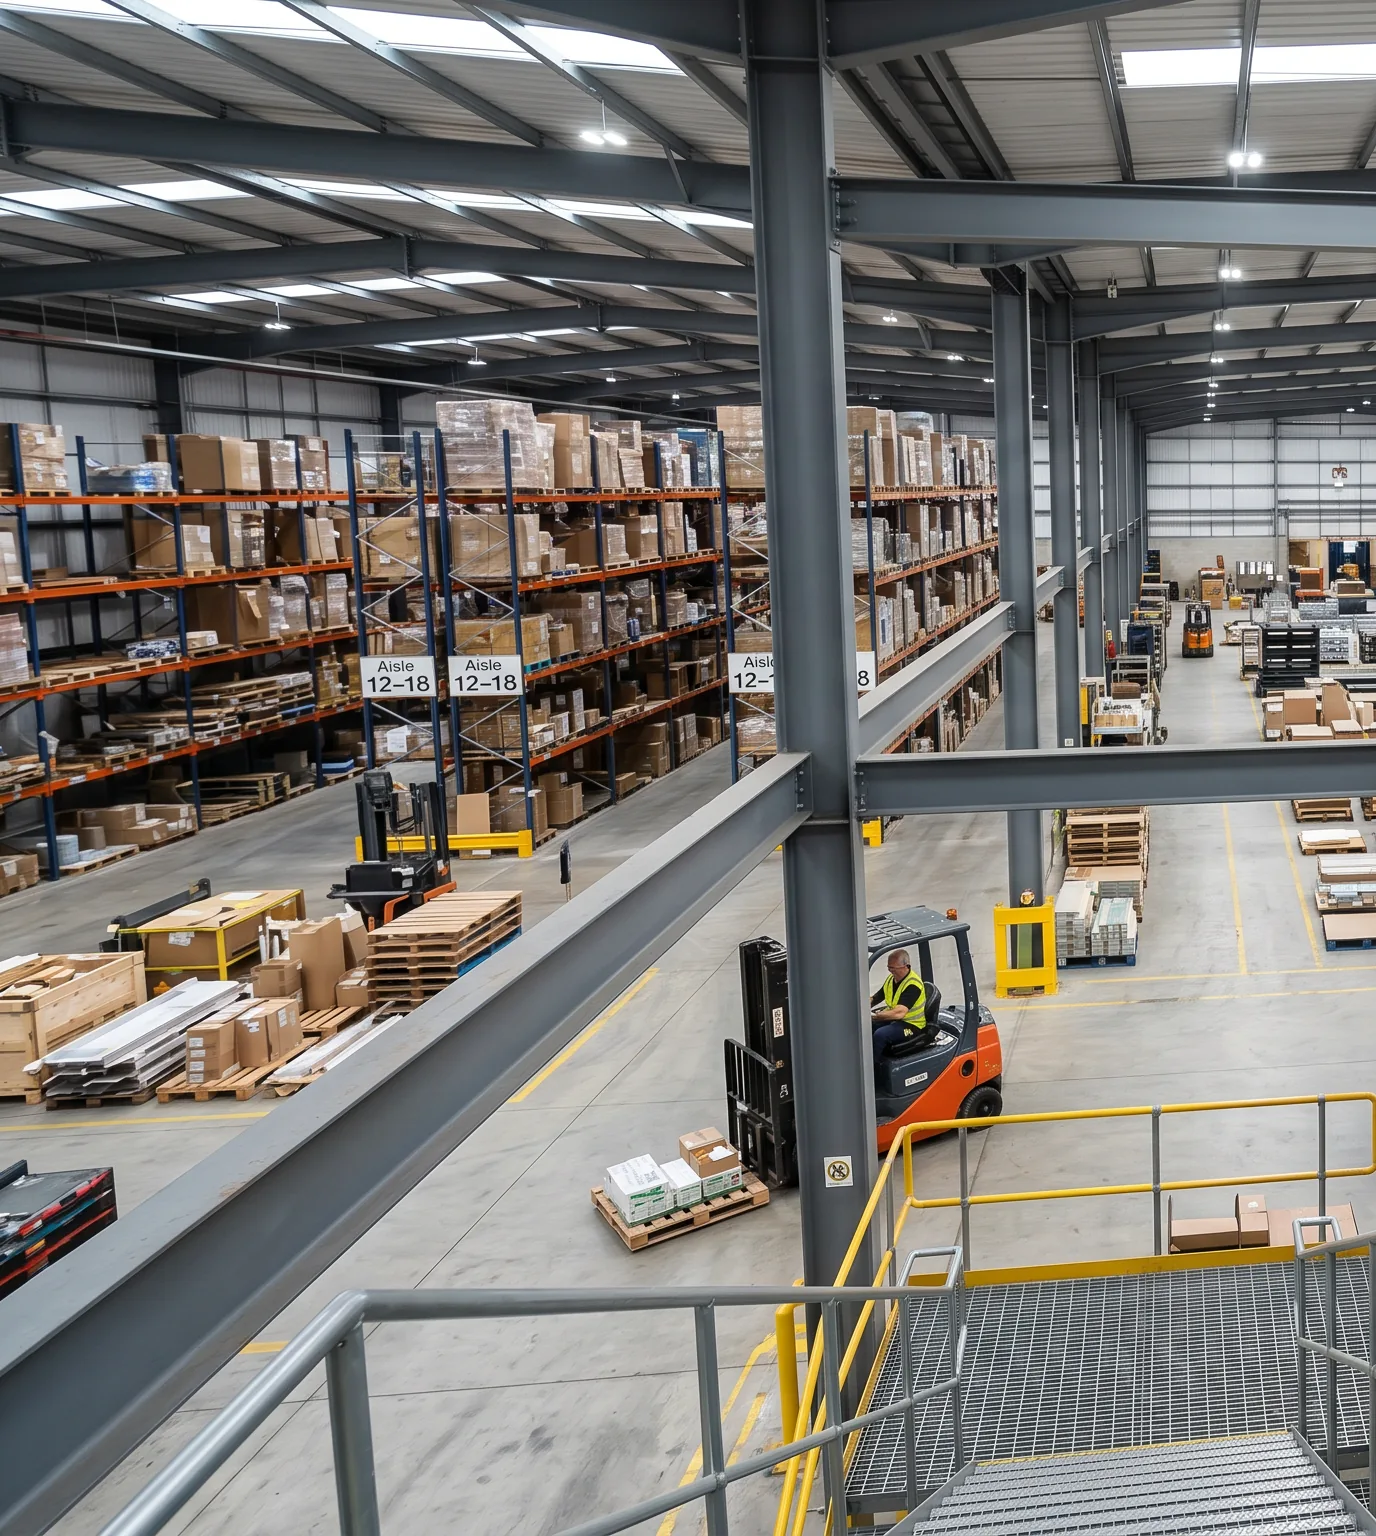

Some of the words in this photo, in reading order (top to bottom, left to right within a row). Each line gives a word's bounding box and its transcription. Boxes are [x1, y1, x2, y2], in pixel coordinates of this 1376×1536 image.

[377, 660, 414, 672] Aisle
[465, 659, 502, 671] Aisle
[367, 675, 430, 693] 12–18
[454, 674, 517, 692] 12–18
